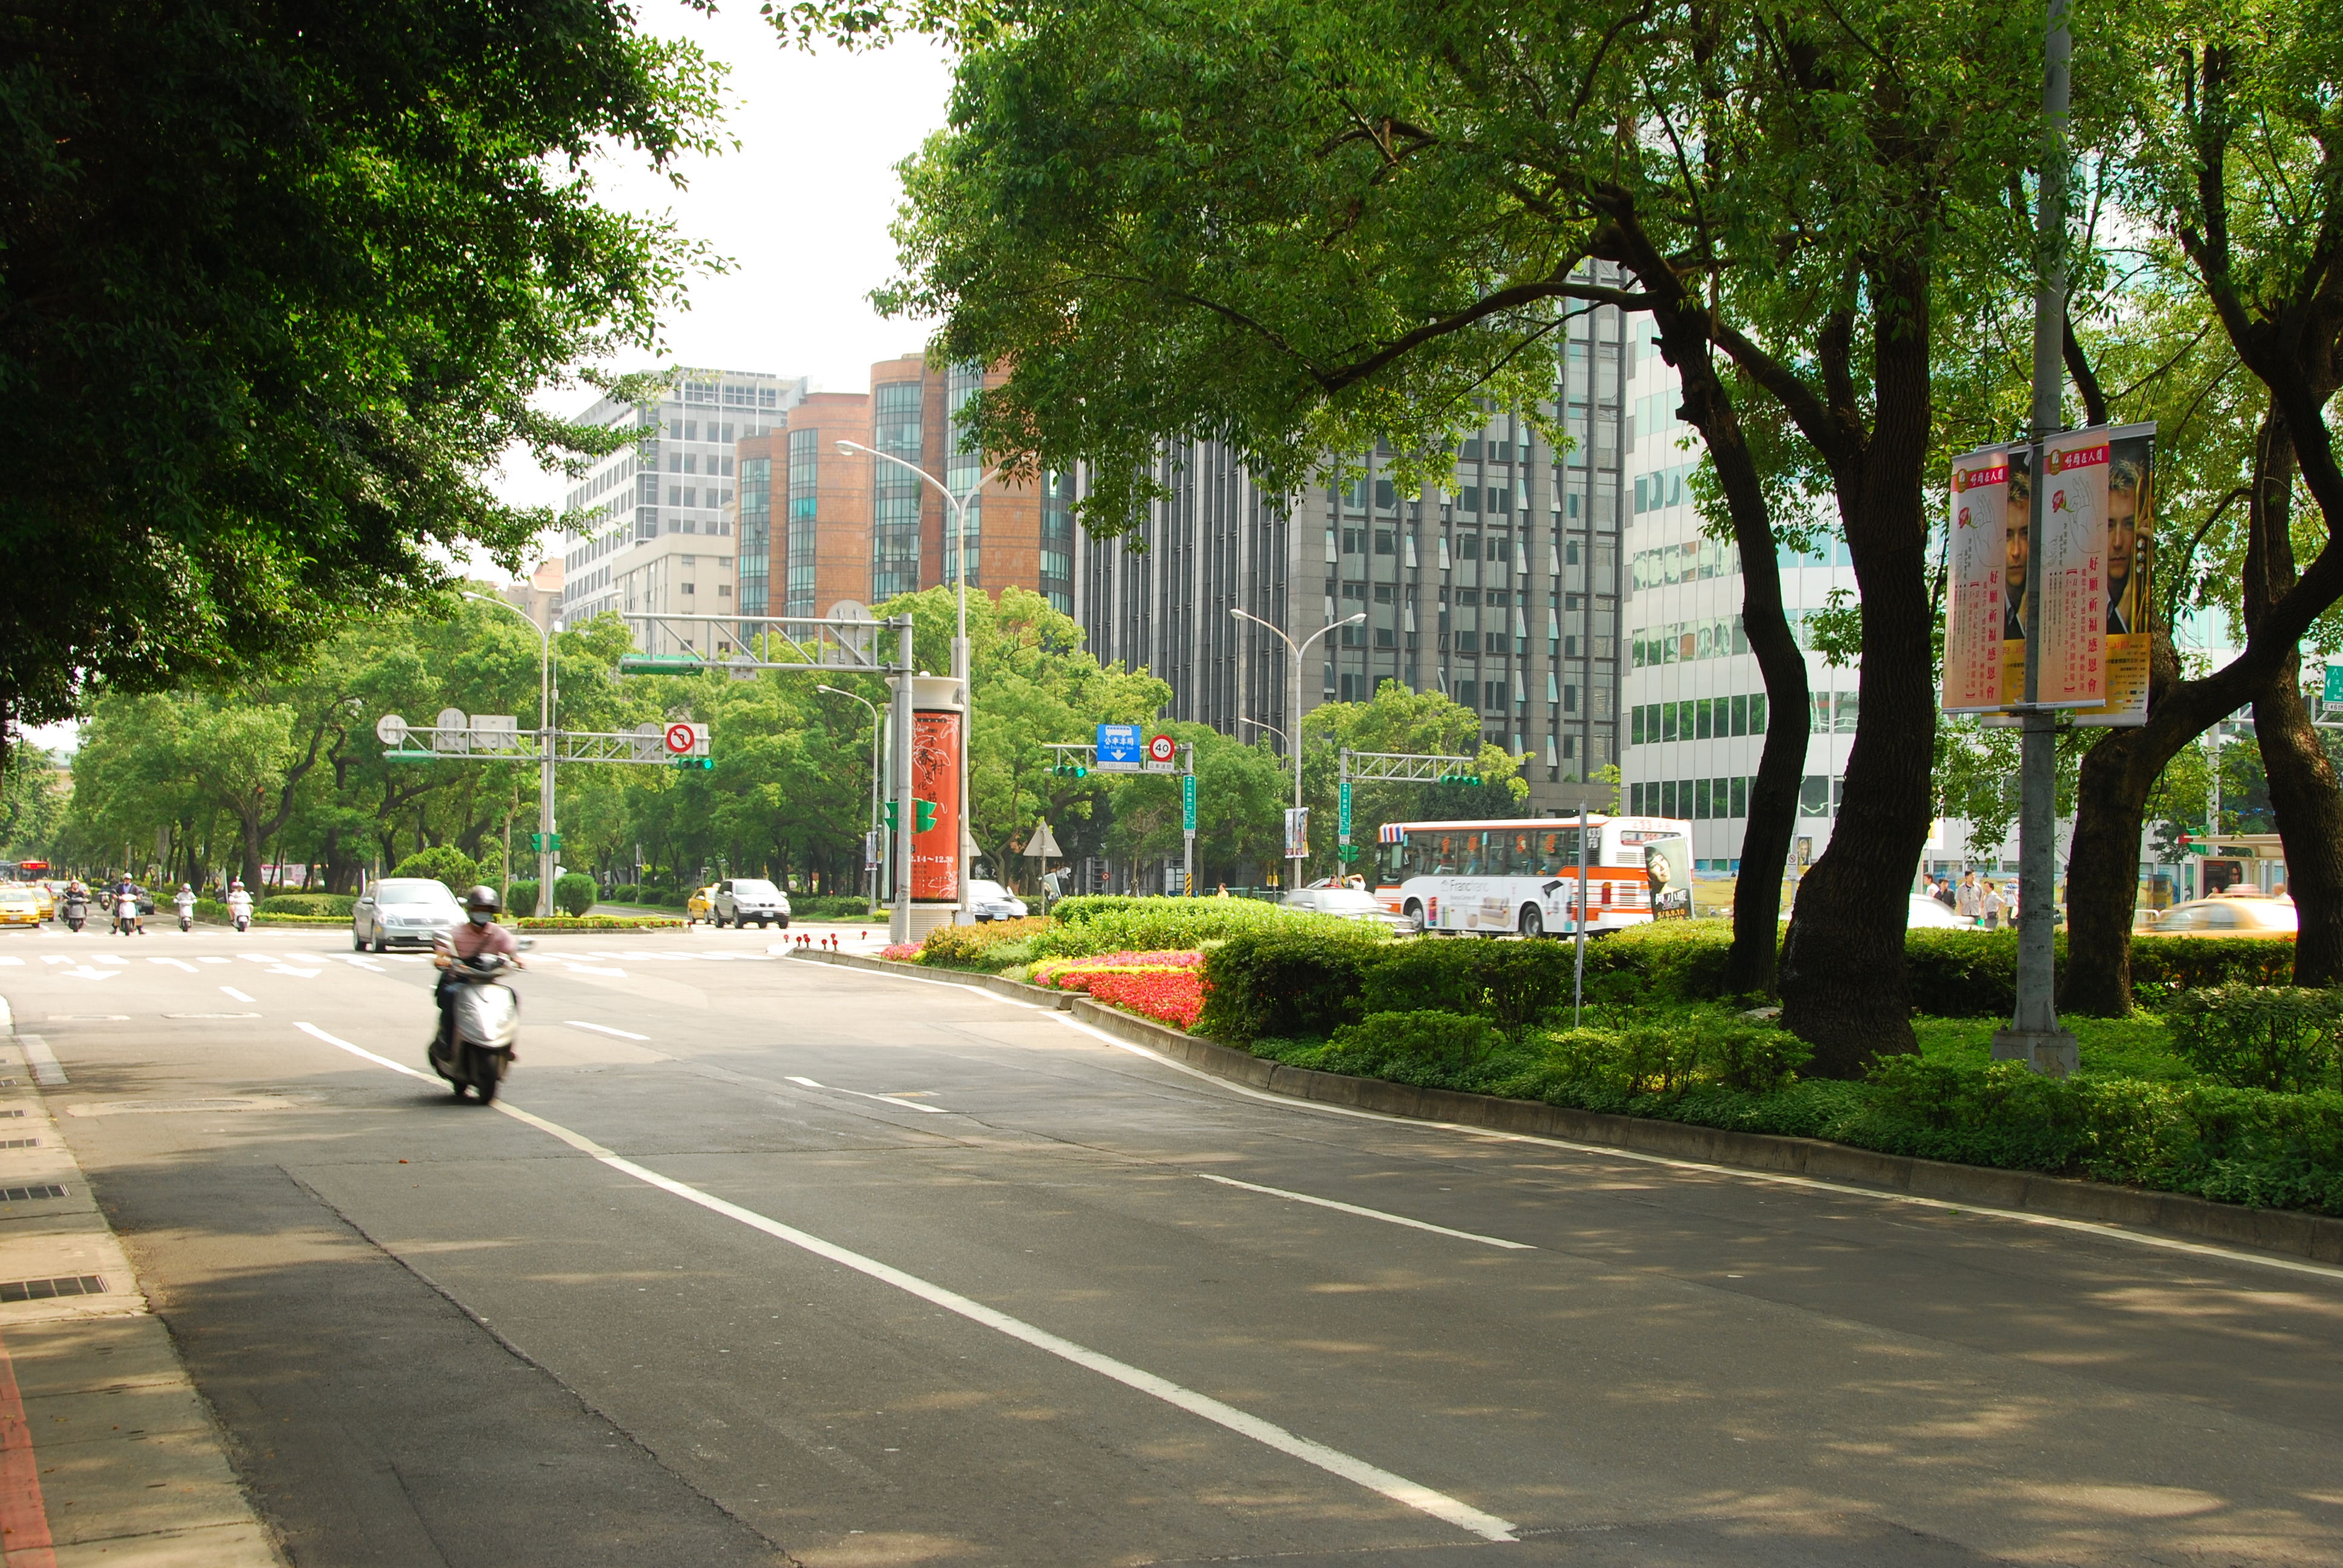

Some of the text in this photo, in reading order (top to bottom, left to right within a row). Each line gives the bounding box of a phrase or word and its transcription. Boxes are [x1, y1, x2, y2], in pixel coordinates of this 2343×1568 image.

[2064, 448, 2103, 468] 好願在人間
[1970, 468, 2004, 486] 好願在人間
[2088, 557, 2099, 693] 好願祈福感恩會
[1987, 570, 1998, 699] 好願祈福感恩會
[1104, 737, 1135, 746] 公車專用
[1155, 743, 1169, 753] 40
[1632, 821, 1672, 831] 433-FB
[1587, 828, 1601, 838] 433
[1587, 838, 1599, 848] FB
[911, 855, 954, 863] 2.14~12.30
[1450, 879, 1490, 892] Francfranc
[1655, 889, 1688, 906] 黃小琥
